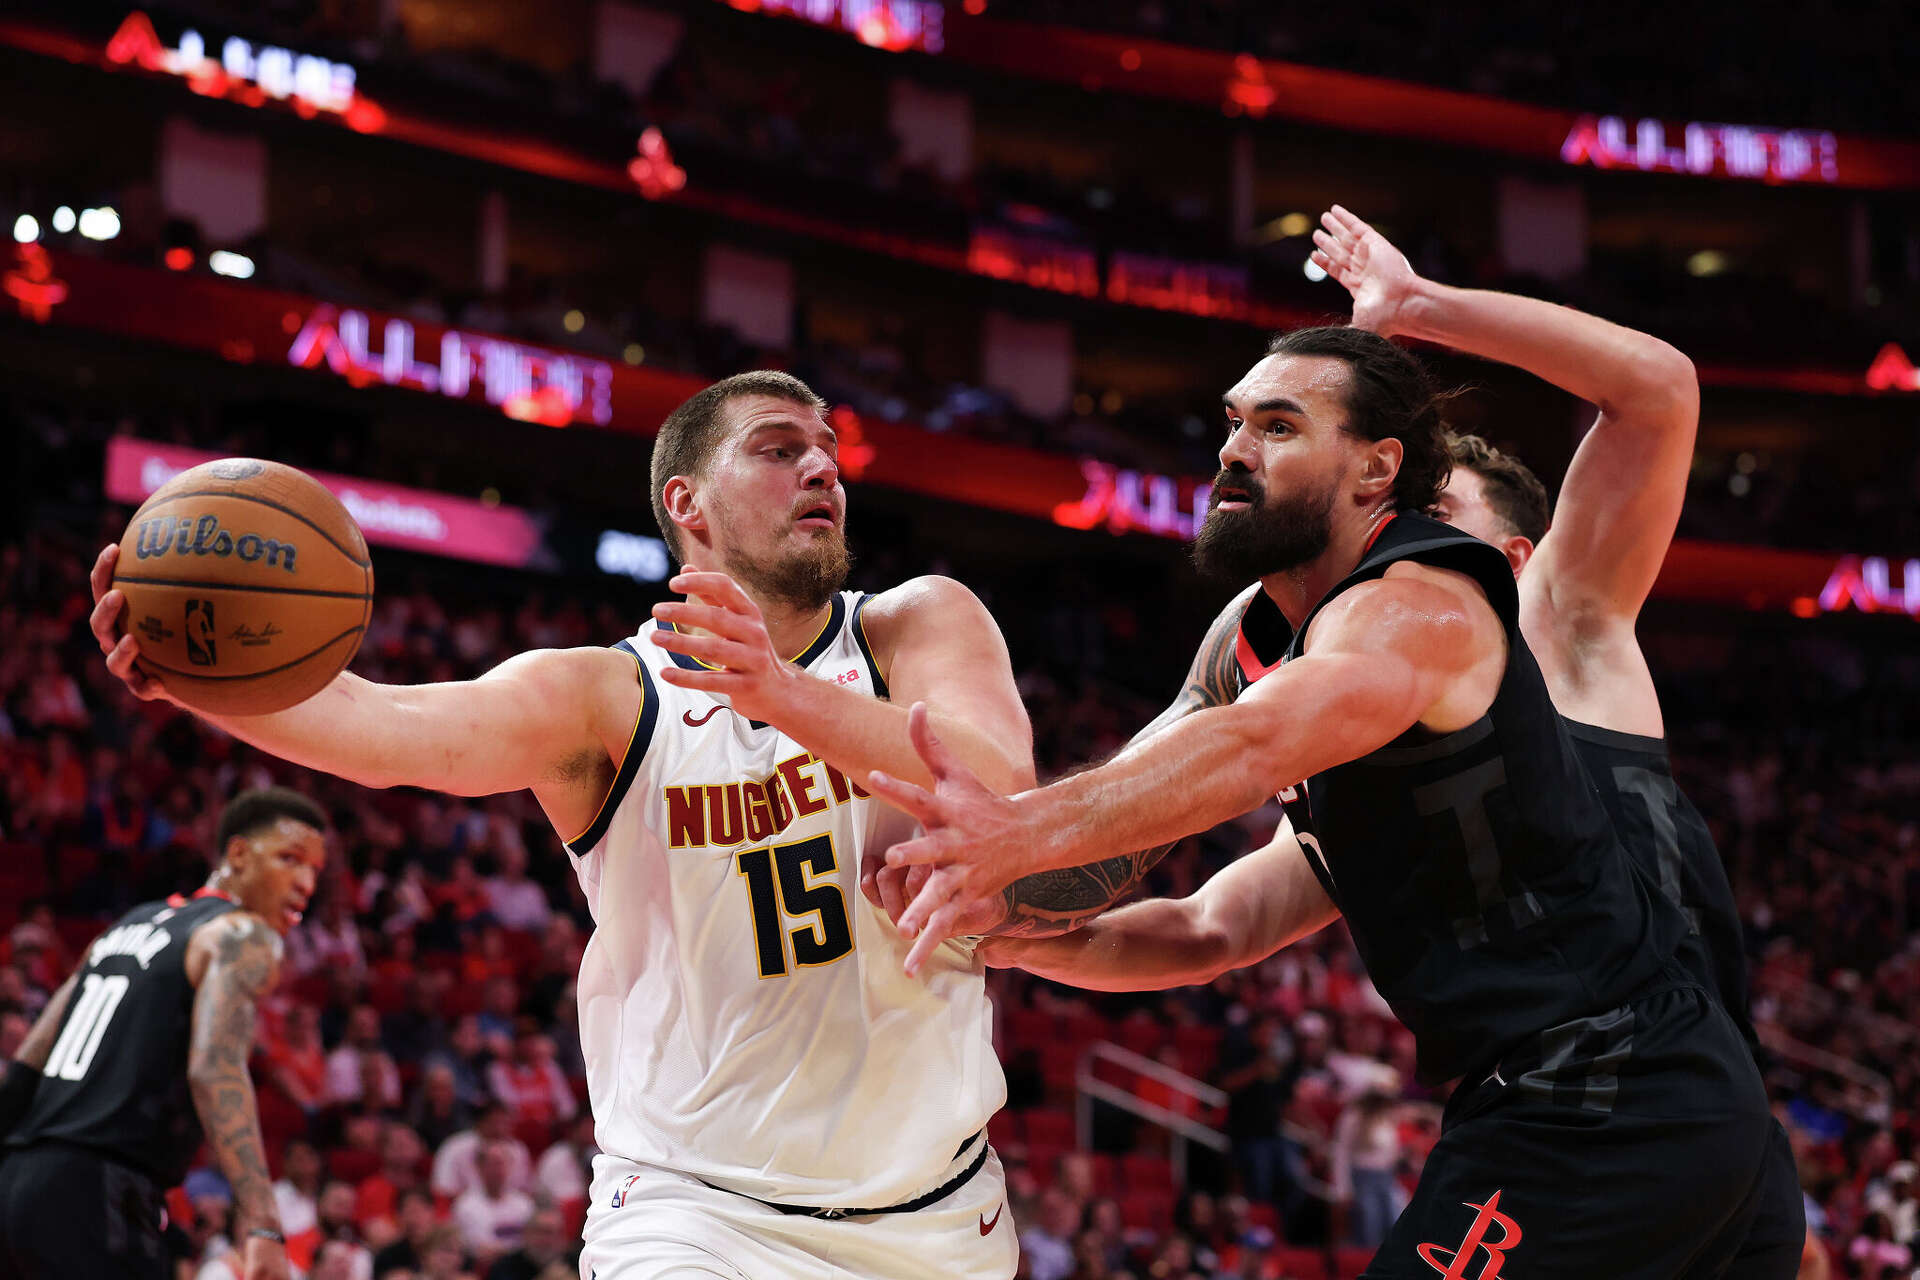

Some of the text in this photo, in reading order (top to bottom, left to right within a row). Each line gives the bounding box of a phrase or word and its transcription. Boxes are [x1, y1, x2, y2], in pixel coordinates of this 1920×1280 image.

[136, 514, 297, 573] Wilson
[664, 752, 872, 849] NUGGET
[735, 831, 856, 980] 15
[43, 972, 130, 1081] 10
